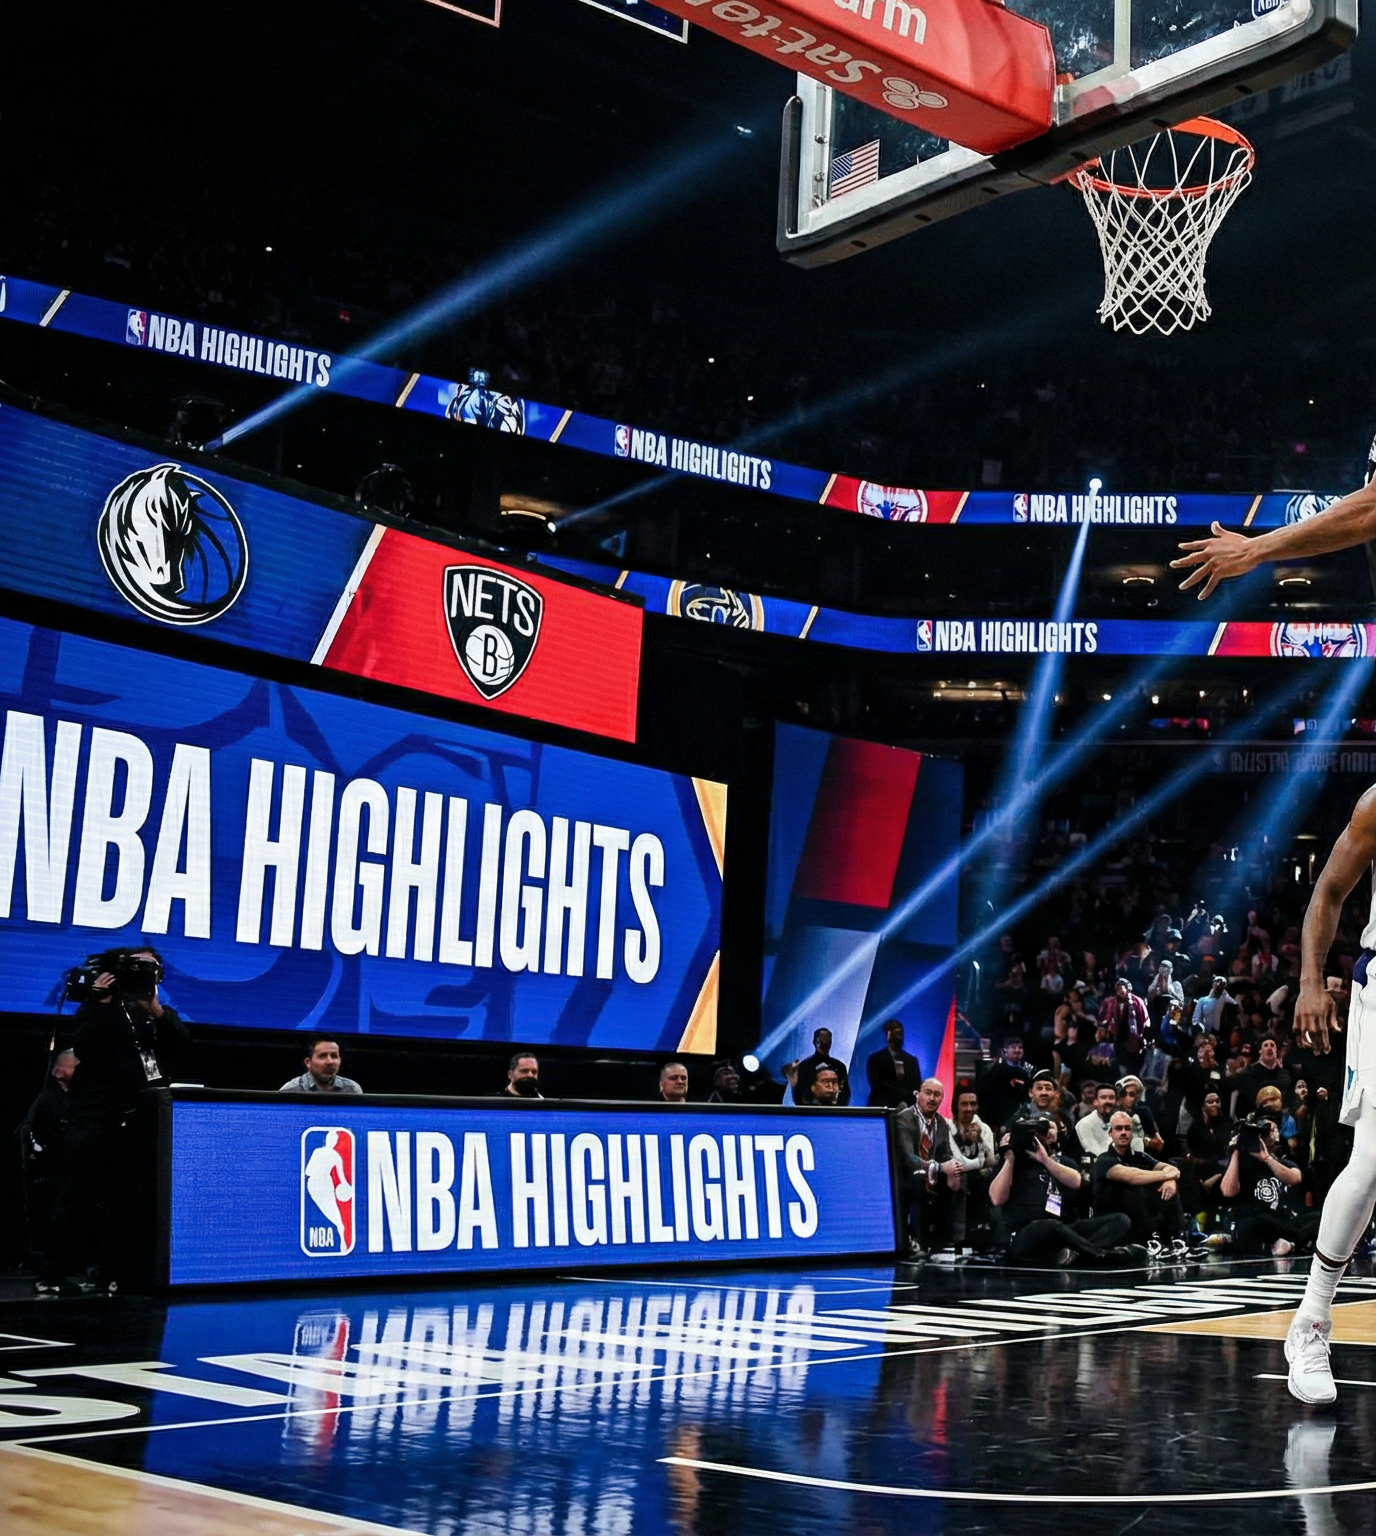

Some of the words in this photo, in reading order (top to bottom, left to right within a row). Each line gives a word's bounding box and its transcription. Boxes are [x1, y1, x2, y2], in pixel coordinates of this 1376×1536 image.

[147, 314, 195, 358] NBA
[200, 326, 331, 388] HIGHLIGHTS
[630, 428, 668, 467] NBA
[670, 438, 772, 490] HIGHLIGHTS
[1030, 494, 1068, 523] NBA
[1071, 494, 1177, 525] HIGHLIGHTS
[450, 572, 536, 637] NETS
[482, 632, 498, 677] B
[935, 620, 977, 652] NBA
[980, 621, 1098, 653] HIGHLIGHTS
[0, 709, 211, 939] NBA
[235, 757, 665, 984] HIGHLIGHTS
[367, 1130, 499, 1253] NBA
[510, 1131, 818, 1248] HIGHLIGHTS
[309, 1226, 335, 1248] NBA
